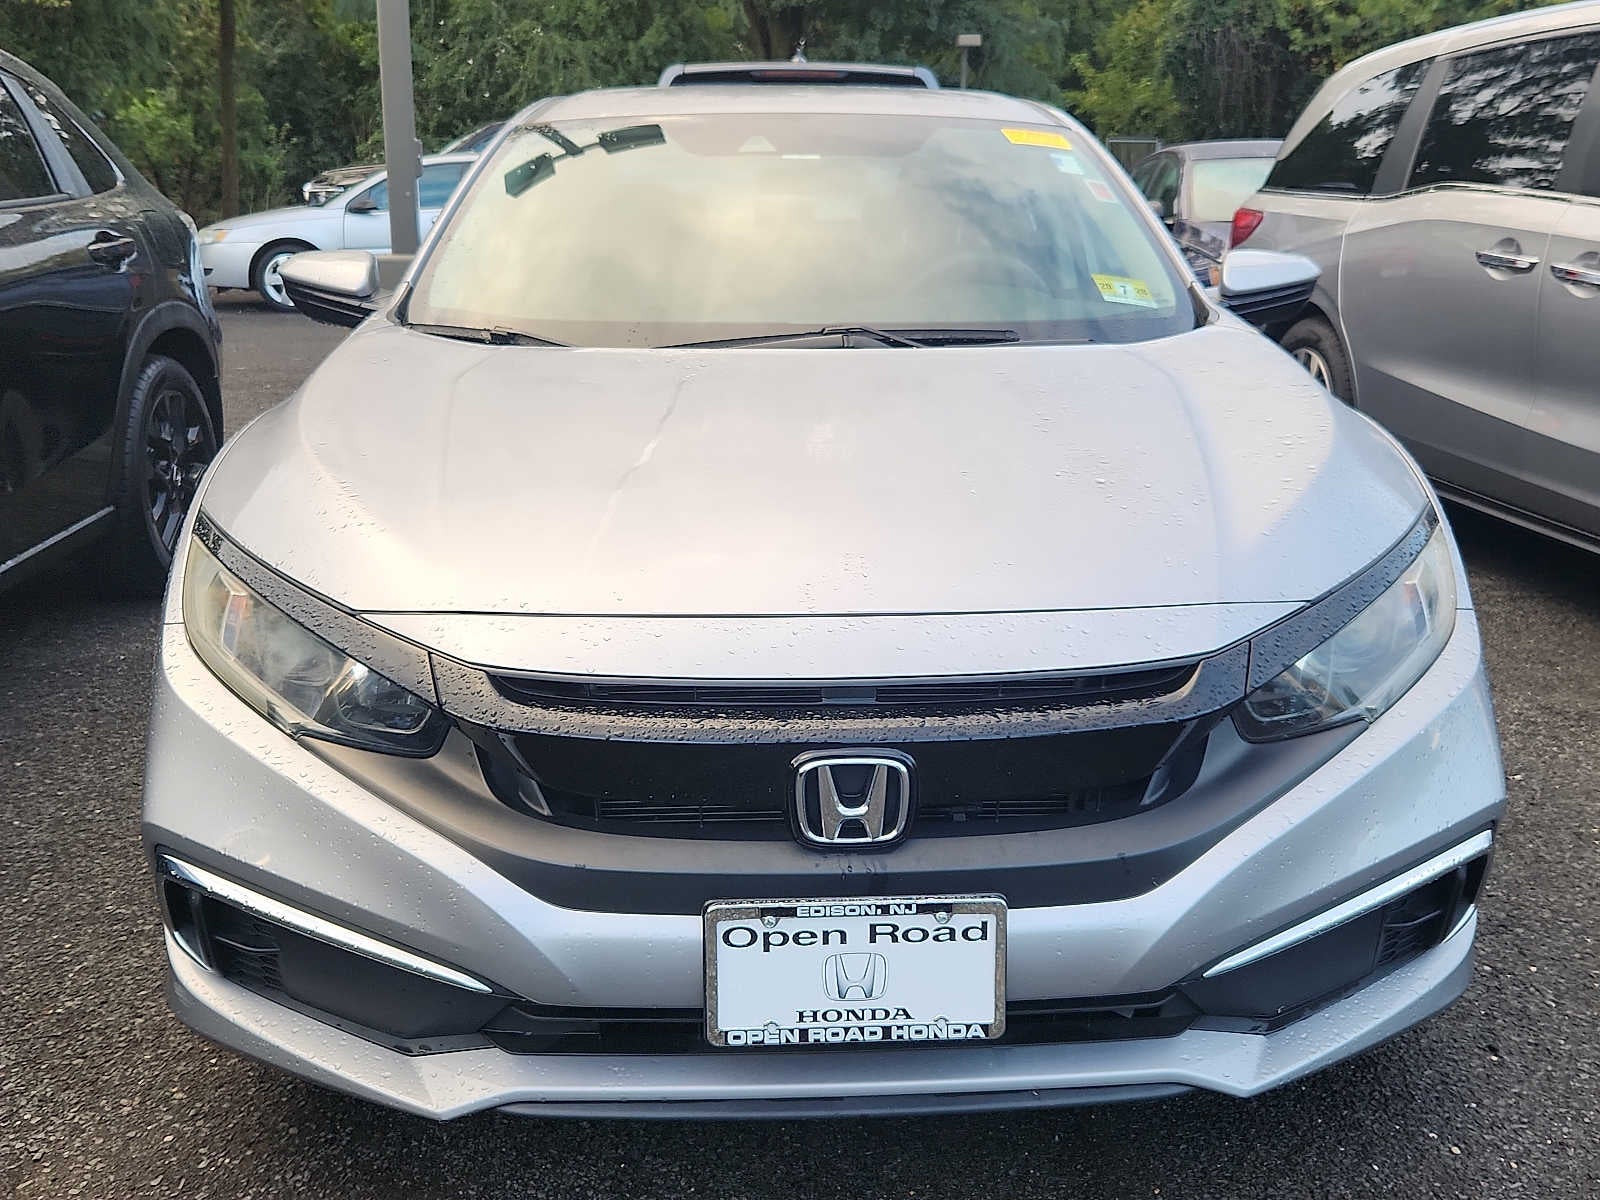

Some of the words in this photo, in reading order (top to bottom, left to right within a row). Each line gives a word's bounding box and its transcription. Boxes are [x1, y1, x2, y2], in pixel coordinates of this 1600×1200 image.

[889, 903, 917, 915] NJ
[722, 926, 847, 952] Open
[869, 920, 988, 943] Road
[796, 1007, 915, 1023] HONDA
[727, 1028, 800, 1045] OPEN
[808, 1026, 883, 1042] ROAD
[891, 1023, 986, 1040] HONDA
